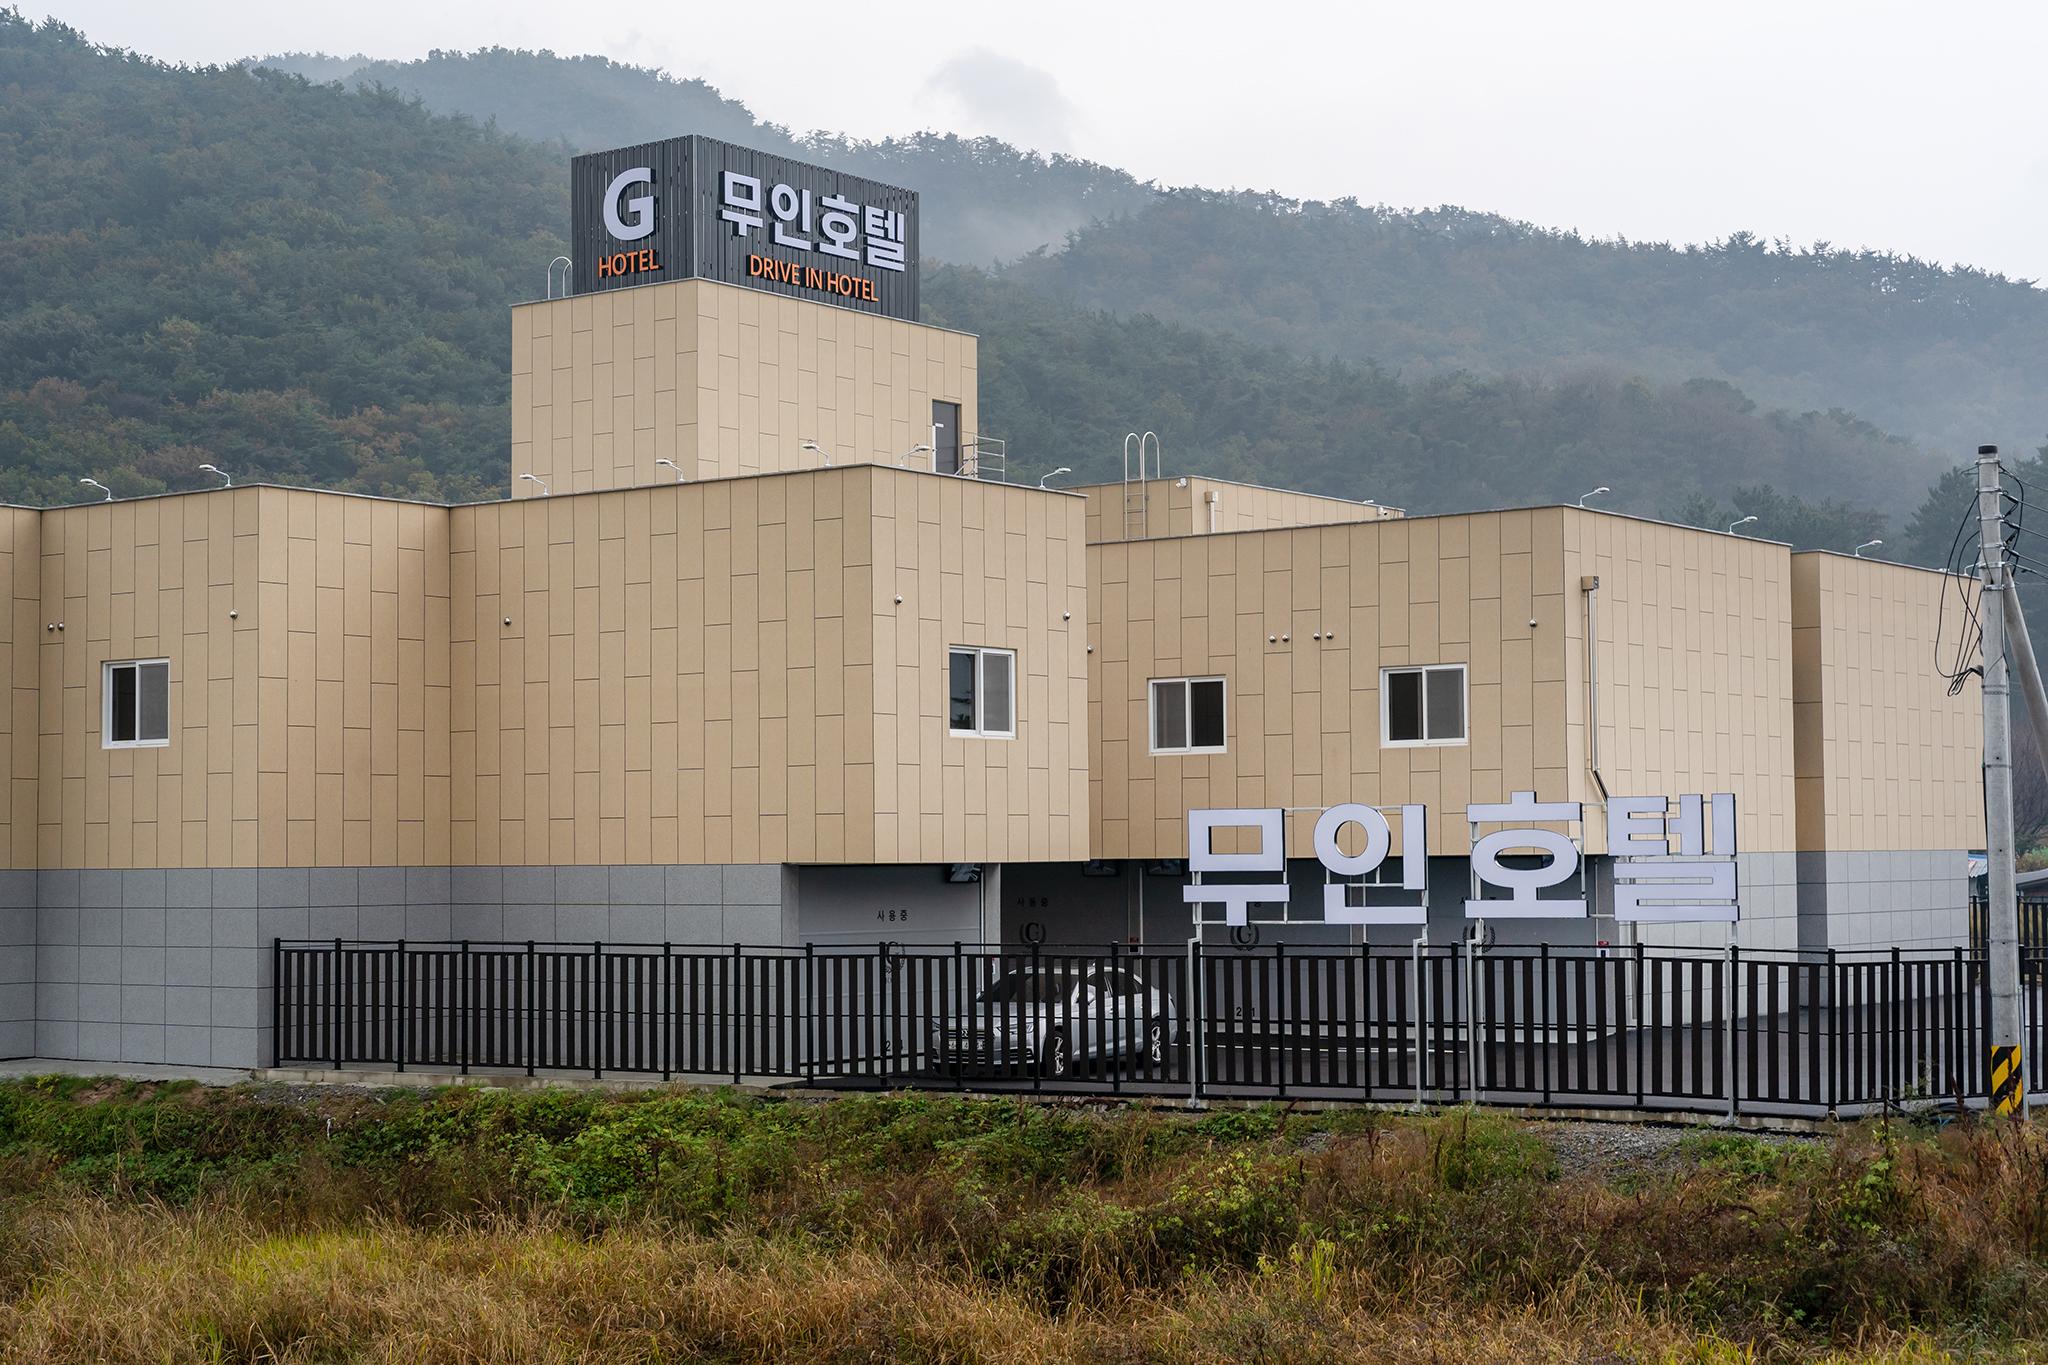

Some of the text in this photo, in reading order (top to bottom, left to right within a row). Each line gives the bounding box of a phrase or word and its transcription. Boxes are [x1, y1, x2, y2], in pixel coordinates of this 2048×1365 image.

[603, 167, 655, 240] G
[722, 170, 905, 272] 무인호텔
[599, 249, 659, 278] HOTEL
[749, 254, 879, 302] DRIVE IN HOTEL
[1183, 791, 1740, 926] 무인호텔
[877, 909, 909, 922] 사용중
